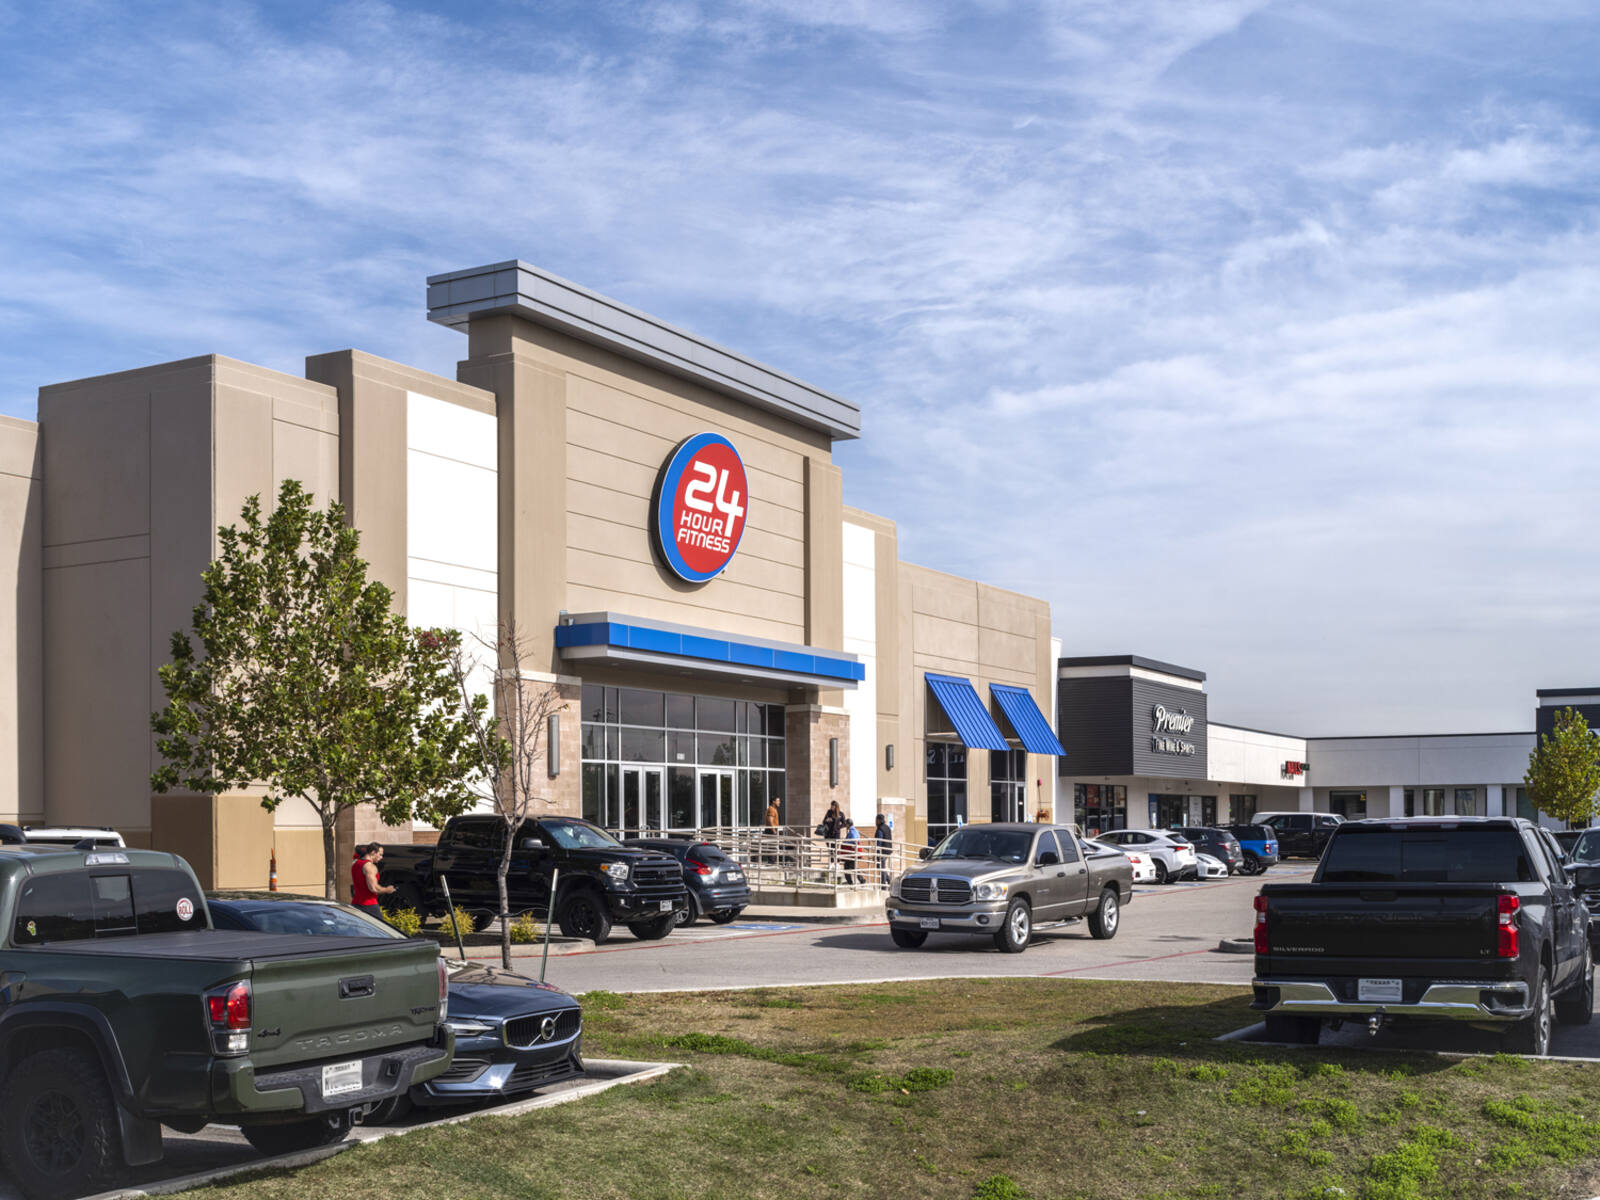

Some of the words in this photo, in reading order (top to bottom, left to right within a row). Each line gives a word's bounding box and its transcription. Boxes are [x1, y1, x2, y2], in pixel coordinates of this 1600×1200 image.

[684, 460, 744, 537] 24
[680, 510, 723, 535] HOUR
[677, 528, 731, 554] FITNESS
[1154, 705, 1194, 733] Premier
[295, 1024, 404, 1051] TACOMA
